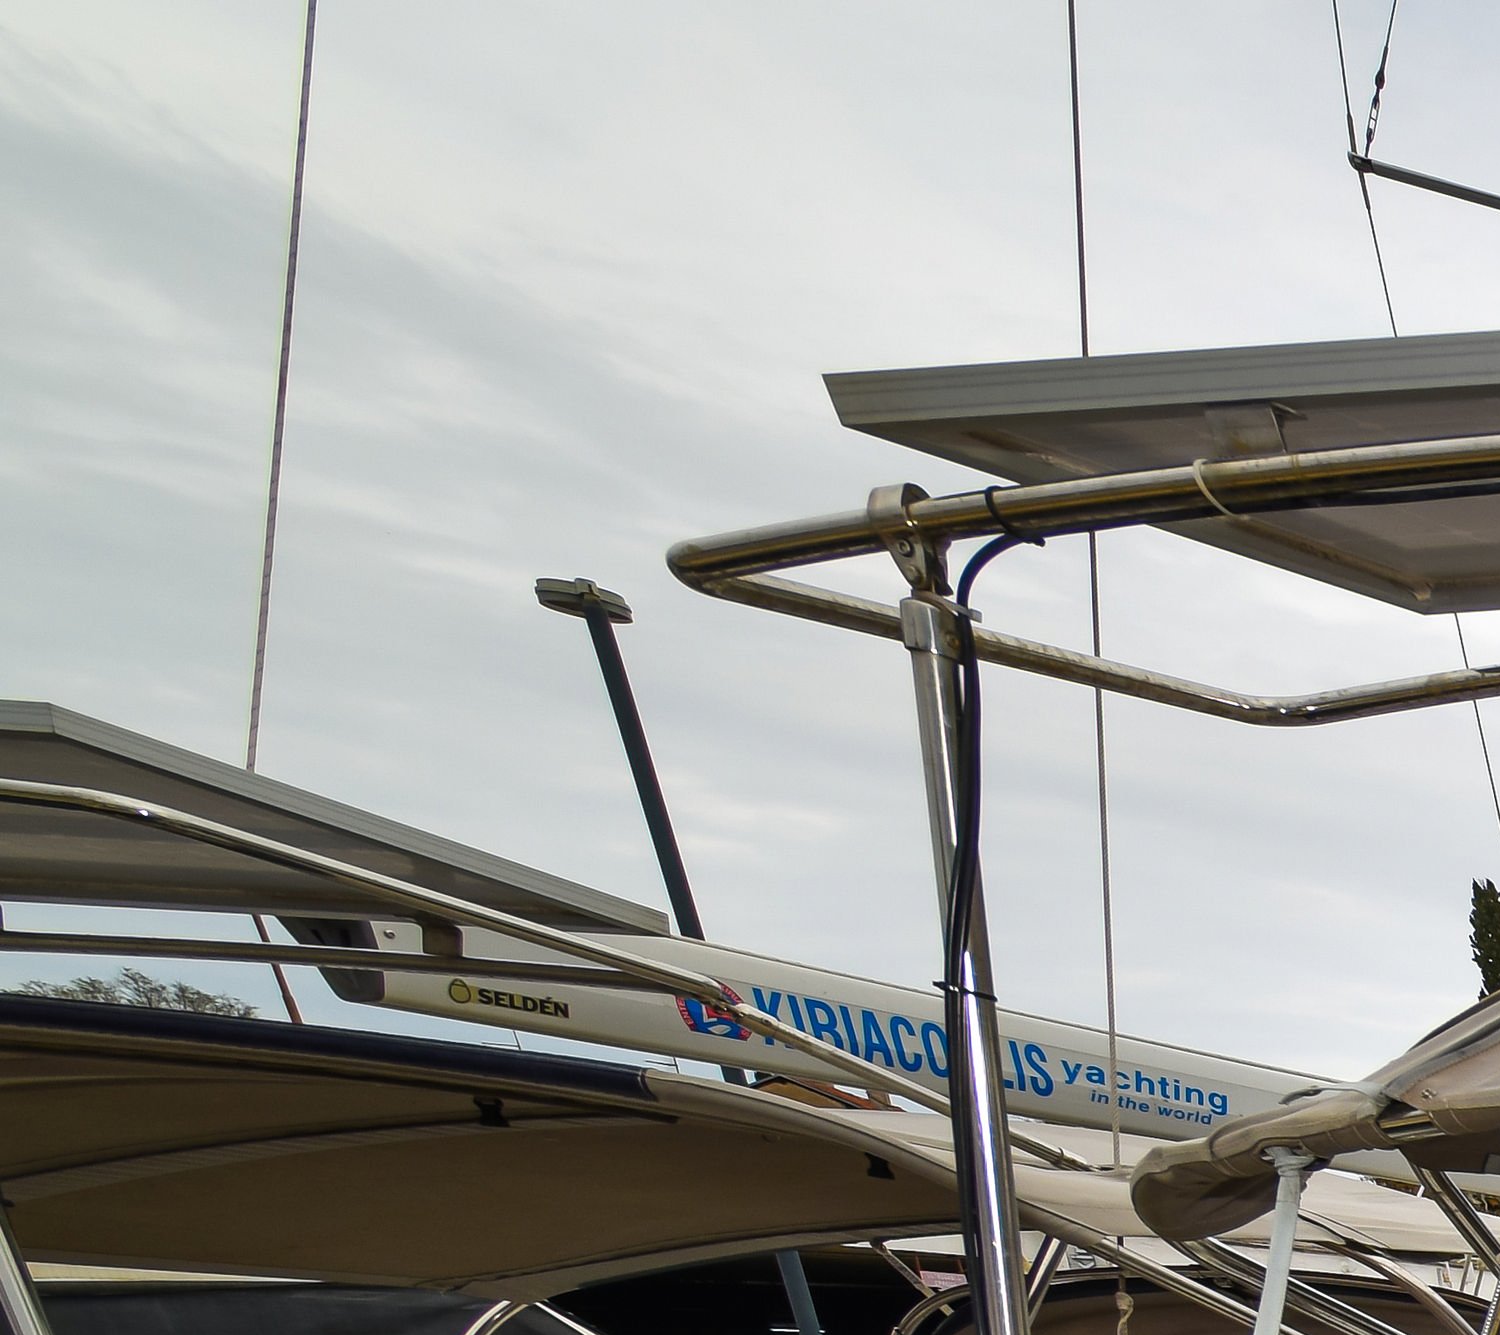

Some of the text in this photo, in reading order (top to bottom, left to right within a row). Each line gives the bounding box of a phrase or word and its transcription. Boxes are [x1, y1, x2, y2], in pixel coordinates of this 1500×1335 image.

[478, 985, 570, 1020] SELDÉN
[1061, 1059, 1228, 1116] yachting
[1091, 1090, 1212, 1125] in the world
